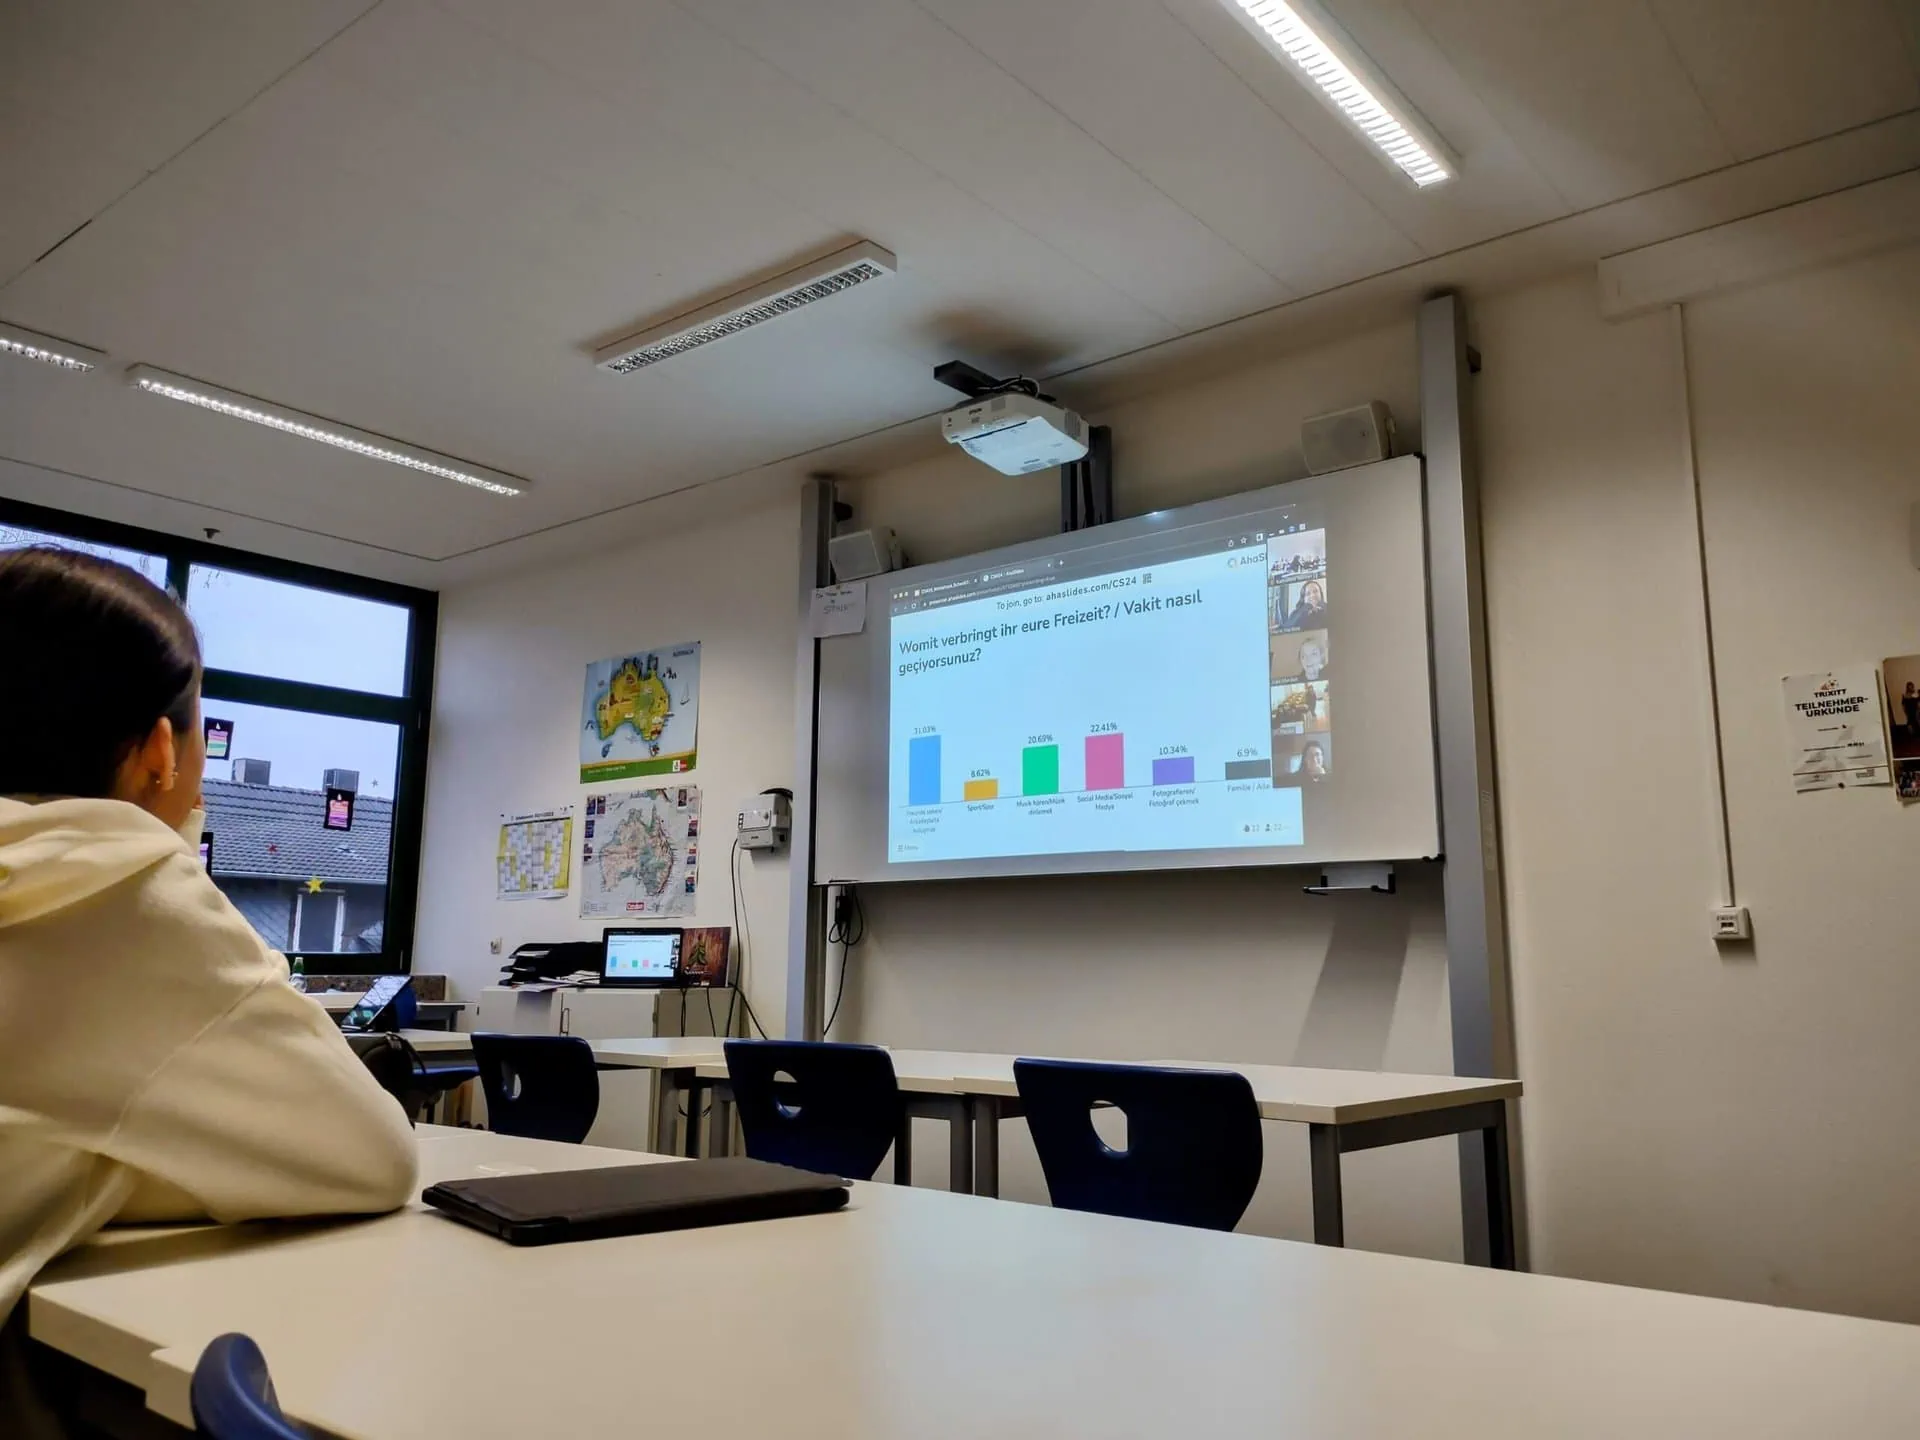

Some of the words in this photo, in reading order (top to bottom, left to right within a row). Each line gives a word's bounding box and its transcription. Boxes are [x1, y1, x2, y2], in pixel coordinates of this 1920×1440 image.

[997, 601, 1006, 610] To
[1006, 597, 1022, 611] join,
[1023, 597, 1033, 607] go
[1046, 576, 1137, 601] ahaslides.com/CS24
[899, 636, 939, 655] Womit
[941, 626, 998, 646] verbringt
[1001, 623, 1018, 638] ihr
[1021, 618, 1050, 633] eure
[1054, 605, 1111, 629] Freizeit?
[1114, 602, 1120, 619] /
[1124, 596, 1162, 616] Vakit
[1165, 588, 1203, 609] nasıl
[899, 647, 982, 676] geçiyorsunuz?
[1814, 688, 1847, 698] TRIXITT
[1795, 696, 1869, 712] TEILNEHMER-
[1806, 704, 1860, 718] URKUNDE
[1090, 722, 1118, 733] 22.41%
[1027, 734, 1053, 744] 20.69%
[1159, 745, 1188, 756] 10.34%
[1236, 748, 1258, 758] 6.9%
[970, 769, 991, 778] 8.62%
